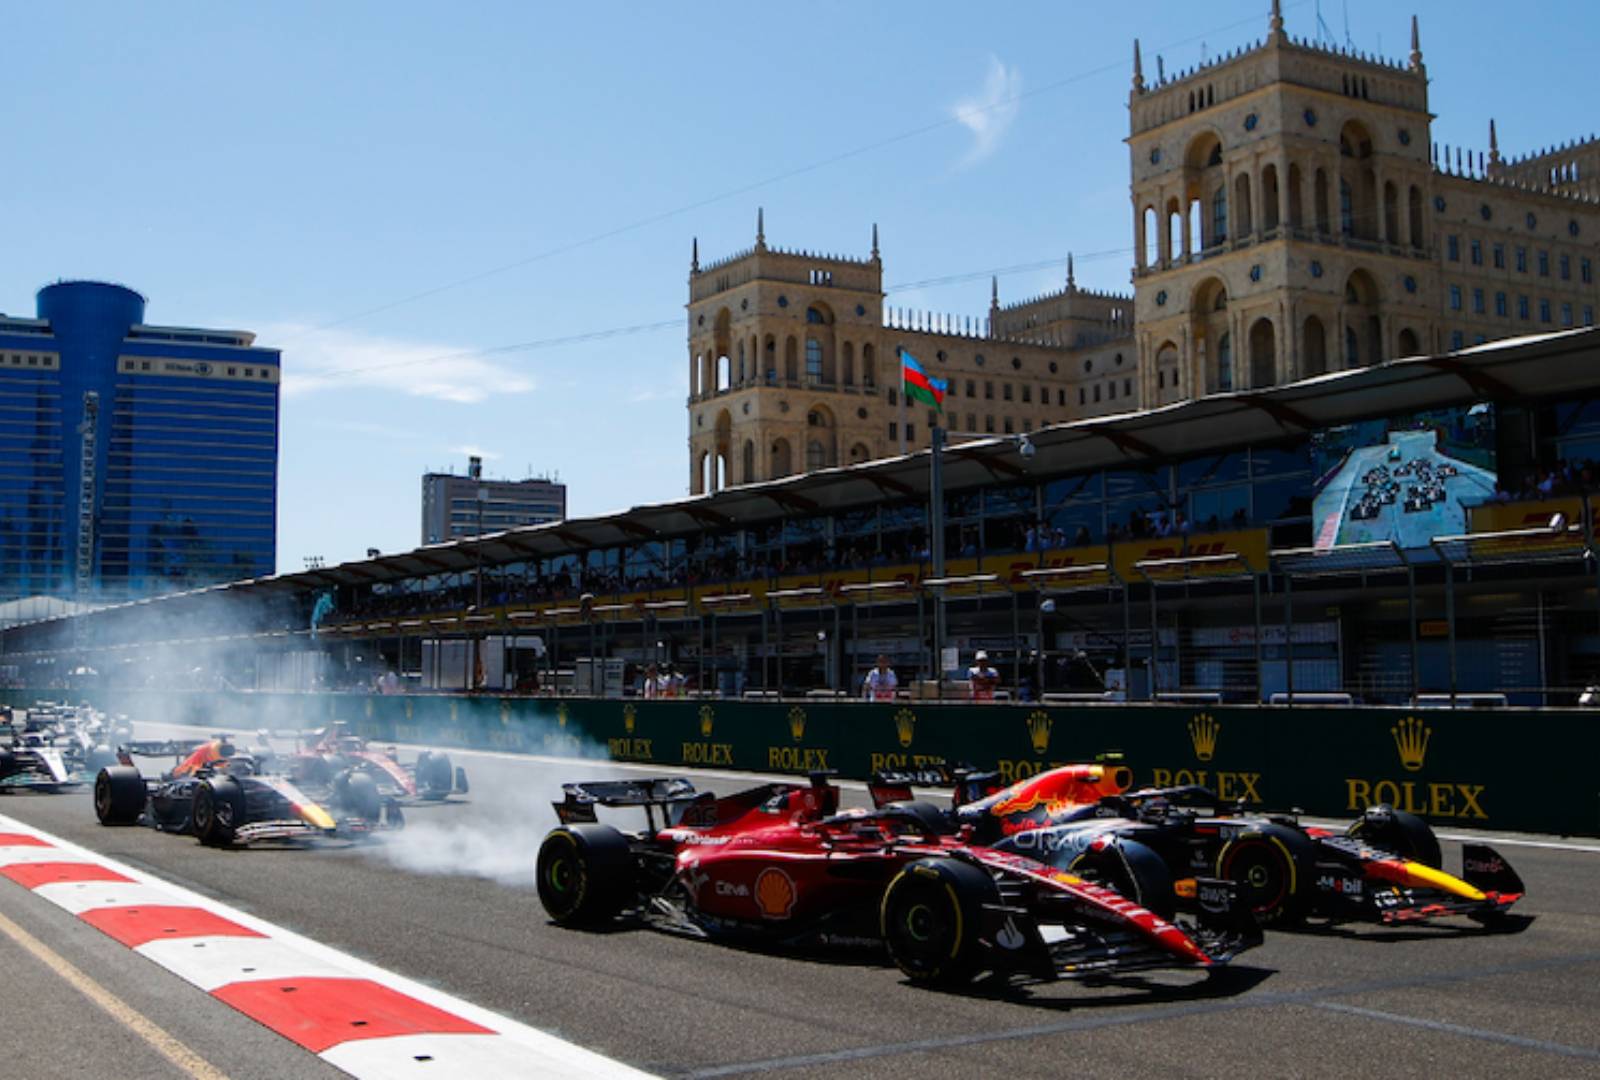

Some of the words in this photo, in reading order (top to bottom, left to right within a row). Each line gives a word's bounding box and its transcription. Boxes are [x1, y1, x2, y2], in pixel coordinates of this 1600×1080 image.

[607, 737, 653, 759] ROLEX
[682, 742, 734, 765] ROLEX
[768, 746, 830, 770] ROLEX
[1345, 778, 1488, 820] ROLEX
